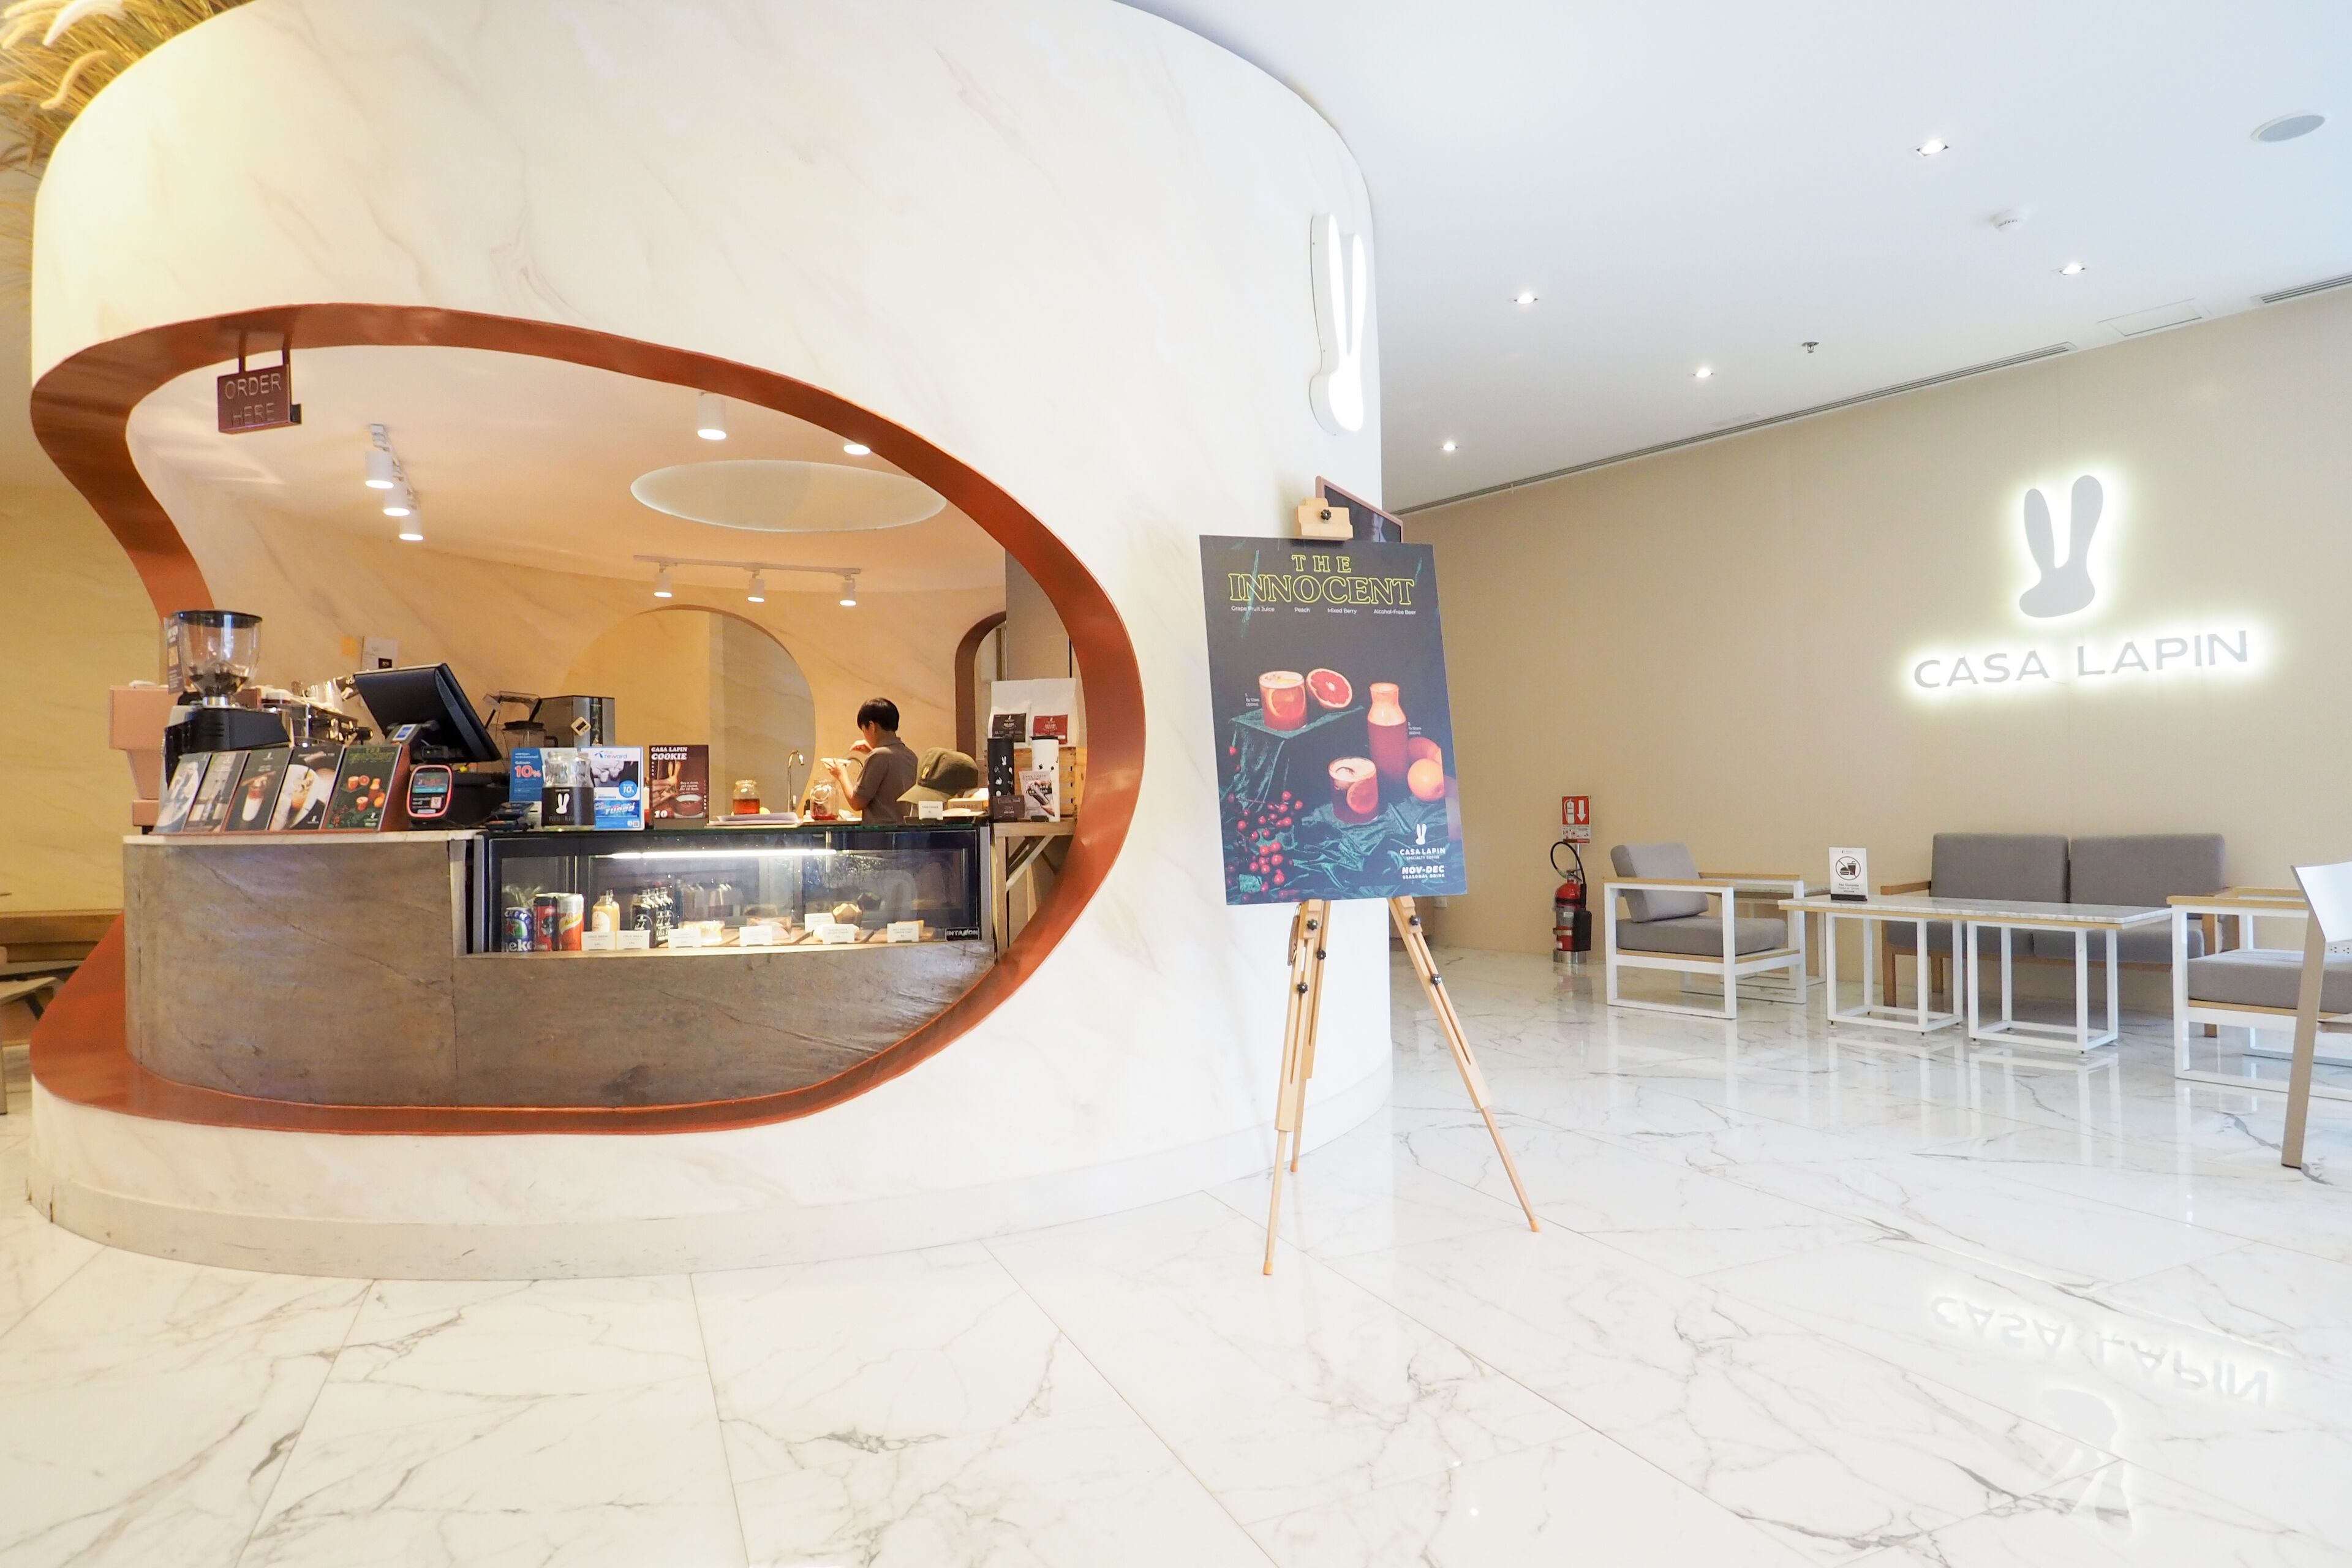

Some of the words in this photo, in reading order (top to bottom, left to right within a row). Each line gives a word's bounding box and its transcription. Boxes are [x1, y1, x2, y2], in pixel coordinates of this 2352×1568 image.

[225, 373, 281, 399] ORDER
[232, 402, 276, 426] HERE
[1292, 554, 1351, 573] THE
[1228, 573, 1414, 605] INNOCENT
[1913, 649, 2050, 689] CASA
[2077, 630, 2248, 677] LAPIN
[514, 765, 541, 778] 10%
